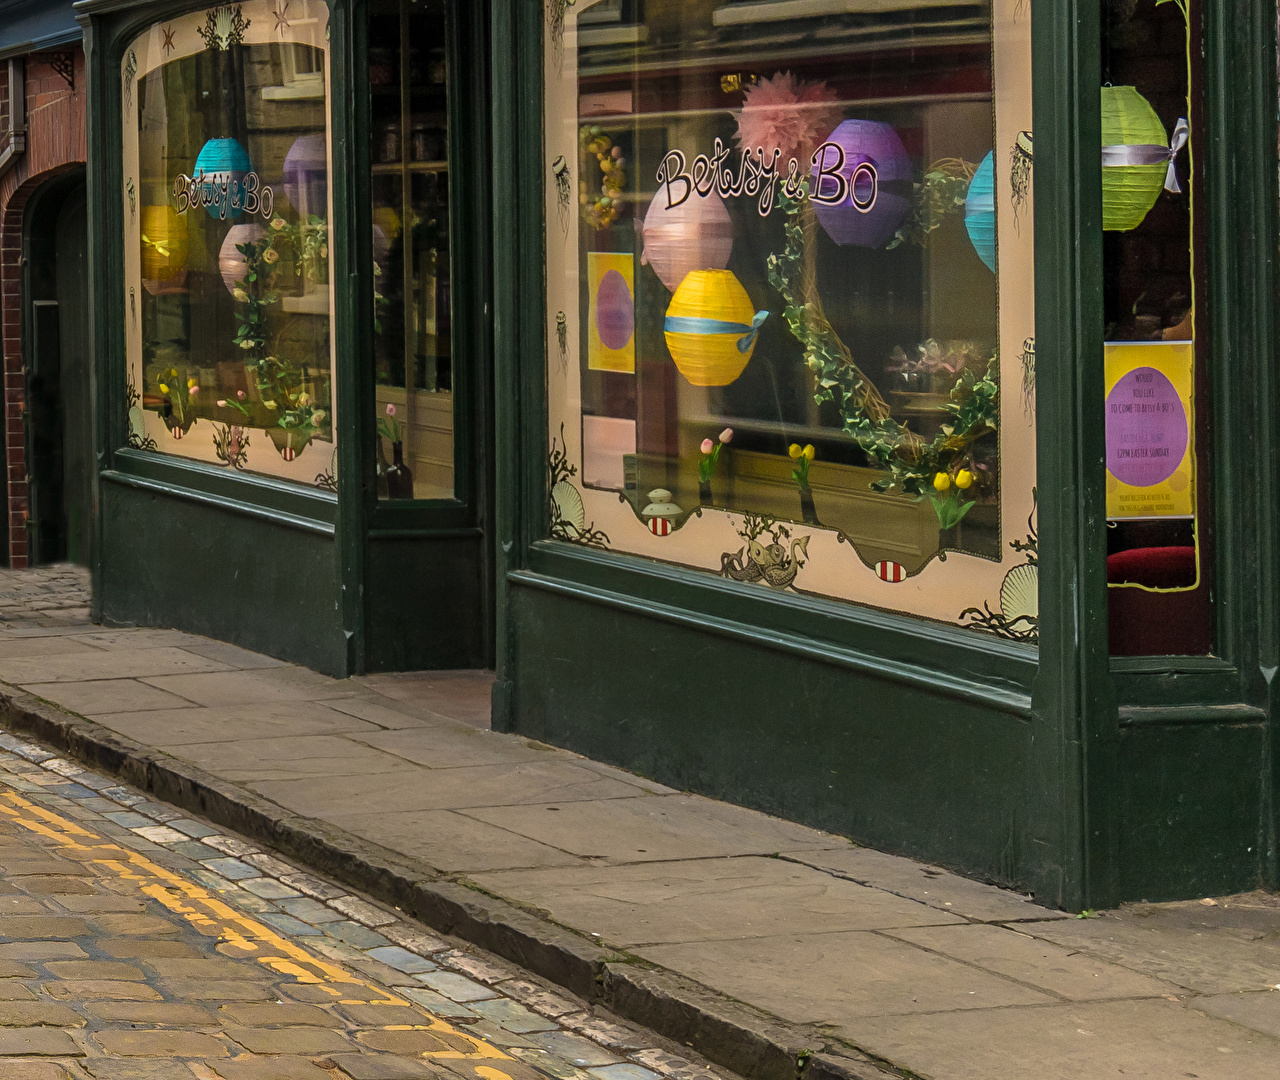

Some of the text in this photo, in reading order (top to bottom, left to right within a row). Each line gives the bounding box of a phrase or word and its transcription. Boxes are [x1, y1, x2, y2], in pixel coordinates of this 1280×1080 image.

[656, 136, 878, 217] Betsy & Bo
[173, 167, 274, 220] Betsy & Bo
[1118, 403, 1132, 413] COME
[1131, 448, 1148, 458] EASTER
[1149, 448, 1169, 458] SUNDAY
